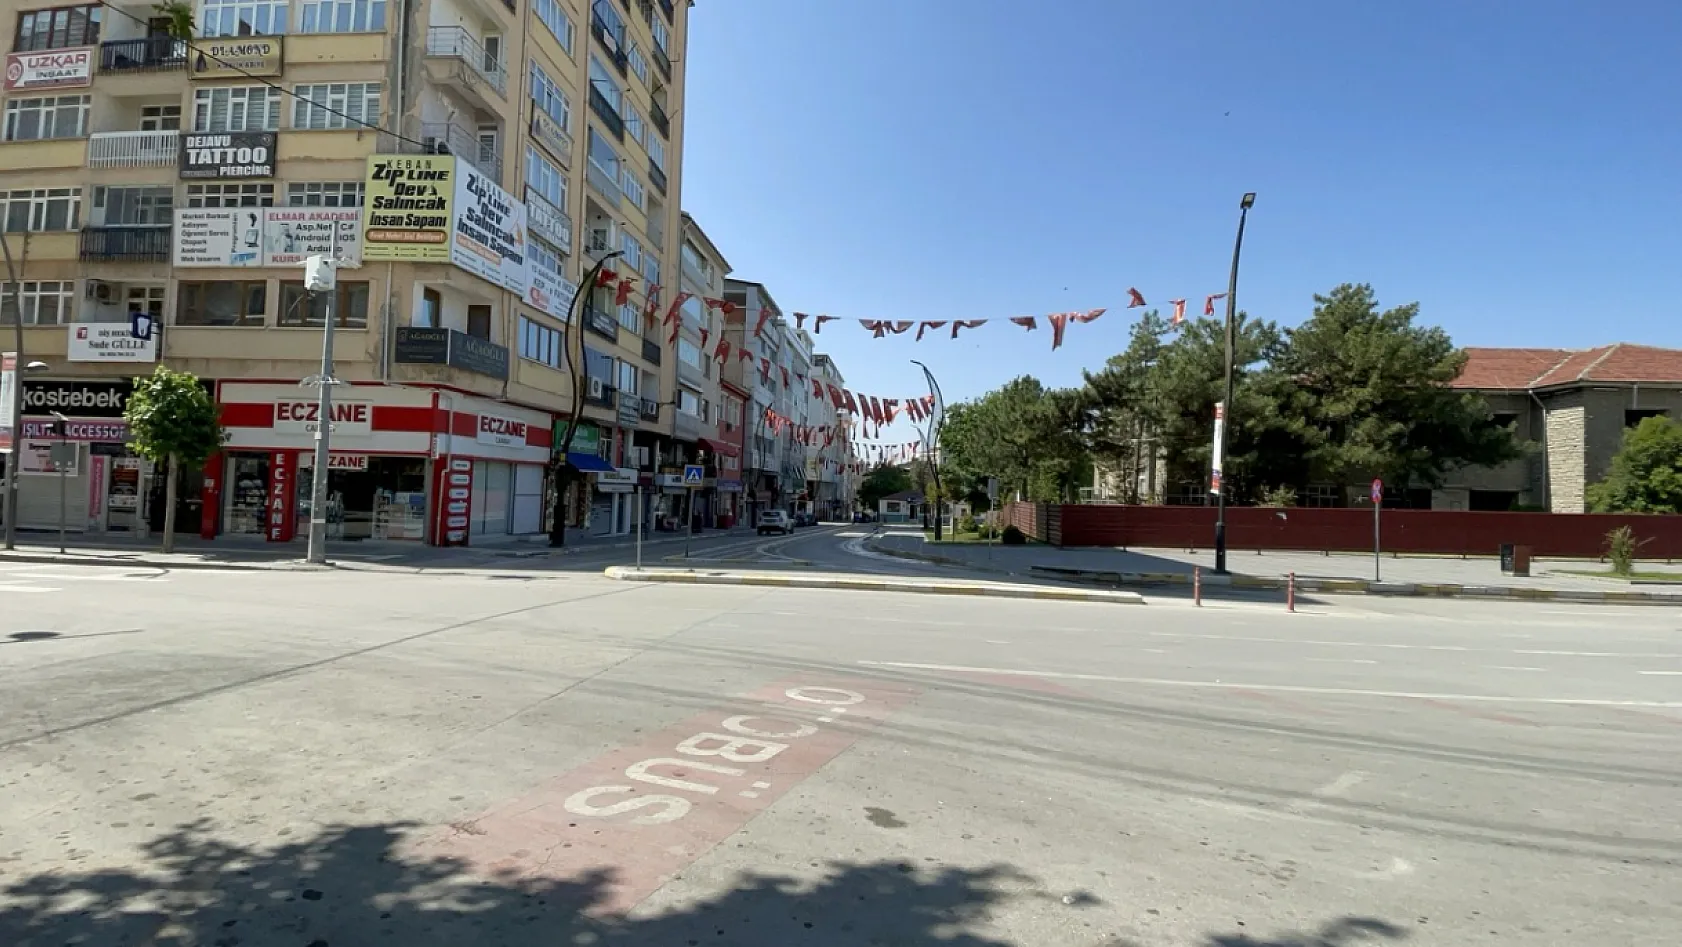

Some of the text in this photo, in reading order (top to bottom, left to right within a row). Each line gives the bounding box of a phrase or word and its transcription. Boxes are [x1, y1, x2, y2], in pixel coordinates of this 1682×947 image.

[28, 54, 87, 69] UZKAR
[187, 135, 231, 148] DEJAVU
[187, 147, 267, 164] TATTOO
[387, 160, 432, 169] KEBAN
[394, 183, 427, 196] Dev
[269, 212, 305, 220] ELMAR
[480, 202, 504, 226] Dev
[294, 234, 330, 242] Android
[22, 386, 123, 409] köstebek
[480, 416, 526, 438] ECZANE
[270, 453, 286, 540] ECZANE
